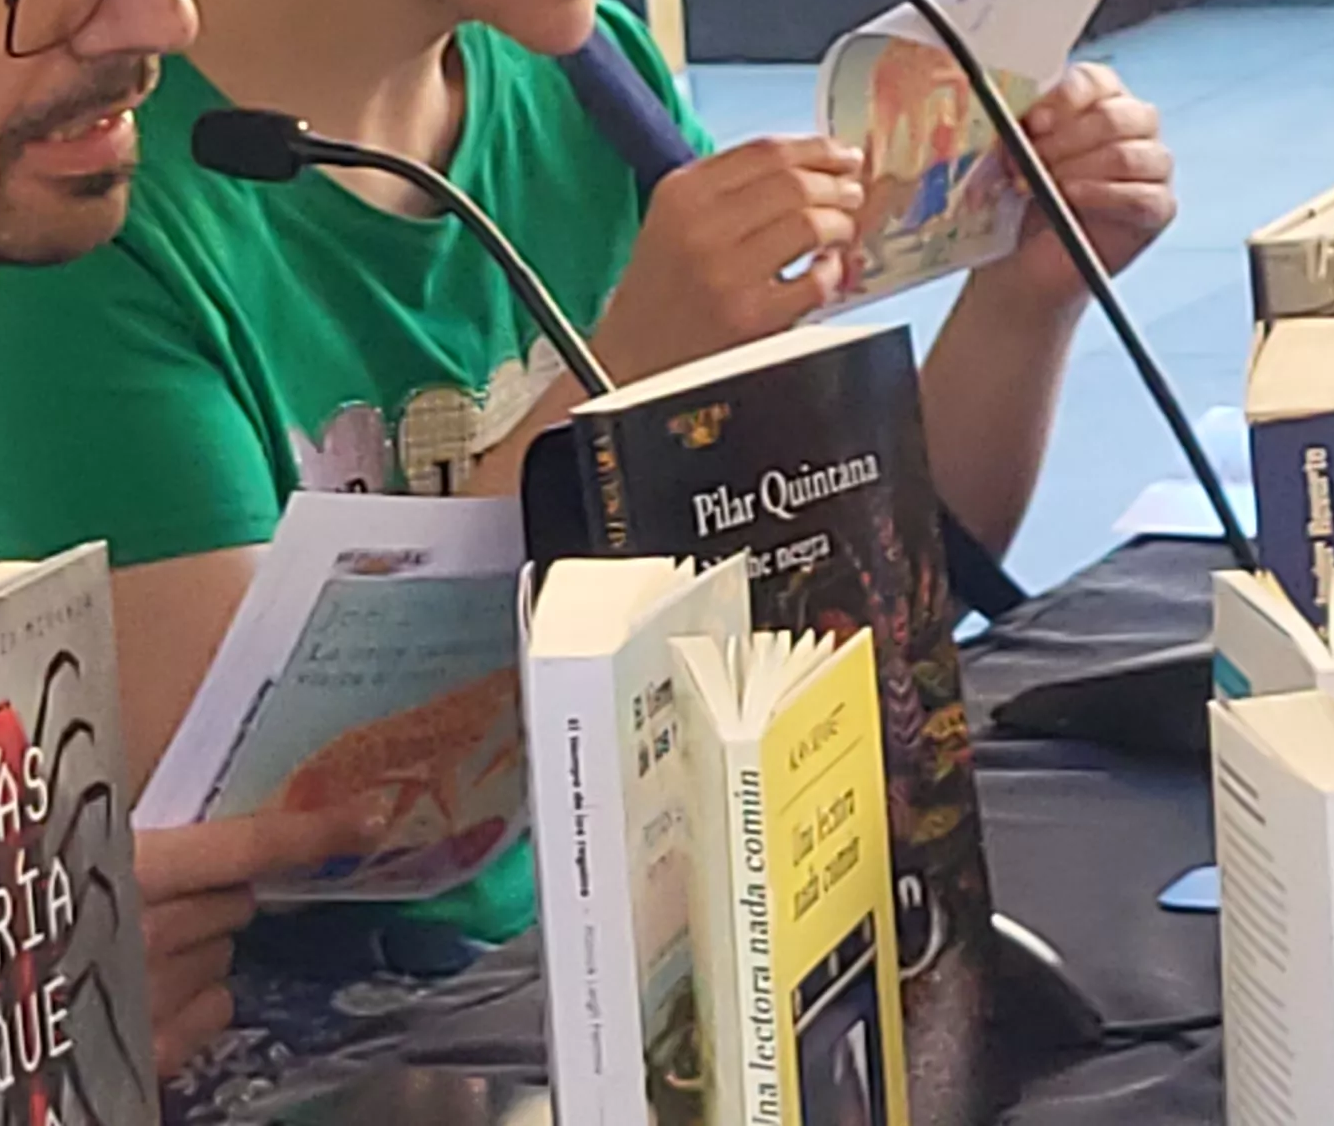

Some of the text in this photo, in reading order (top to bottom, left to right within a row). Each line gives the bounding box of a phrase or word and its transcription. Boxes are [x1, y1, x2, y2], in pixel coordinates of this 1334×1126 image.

[692, 484, 756, 538] Pilar
[760, 453, 880, 520] Quintana
[733, 769, 766, 874] común
[739, 883, 770, 955] nada
[748, 965, 777, 1072] lectora
